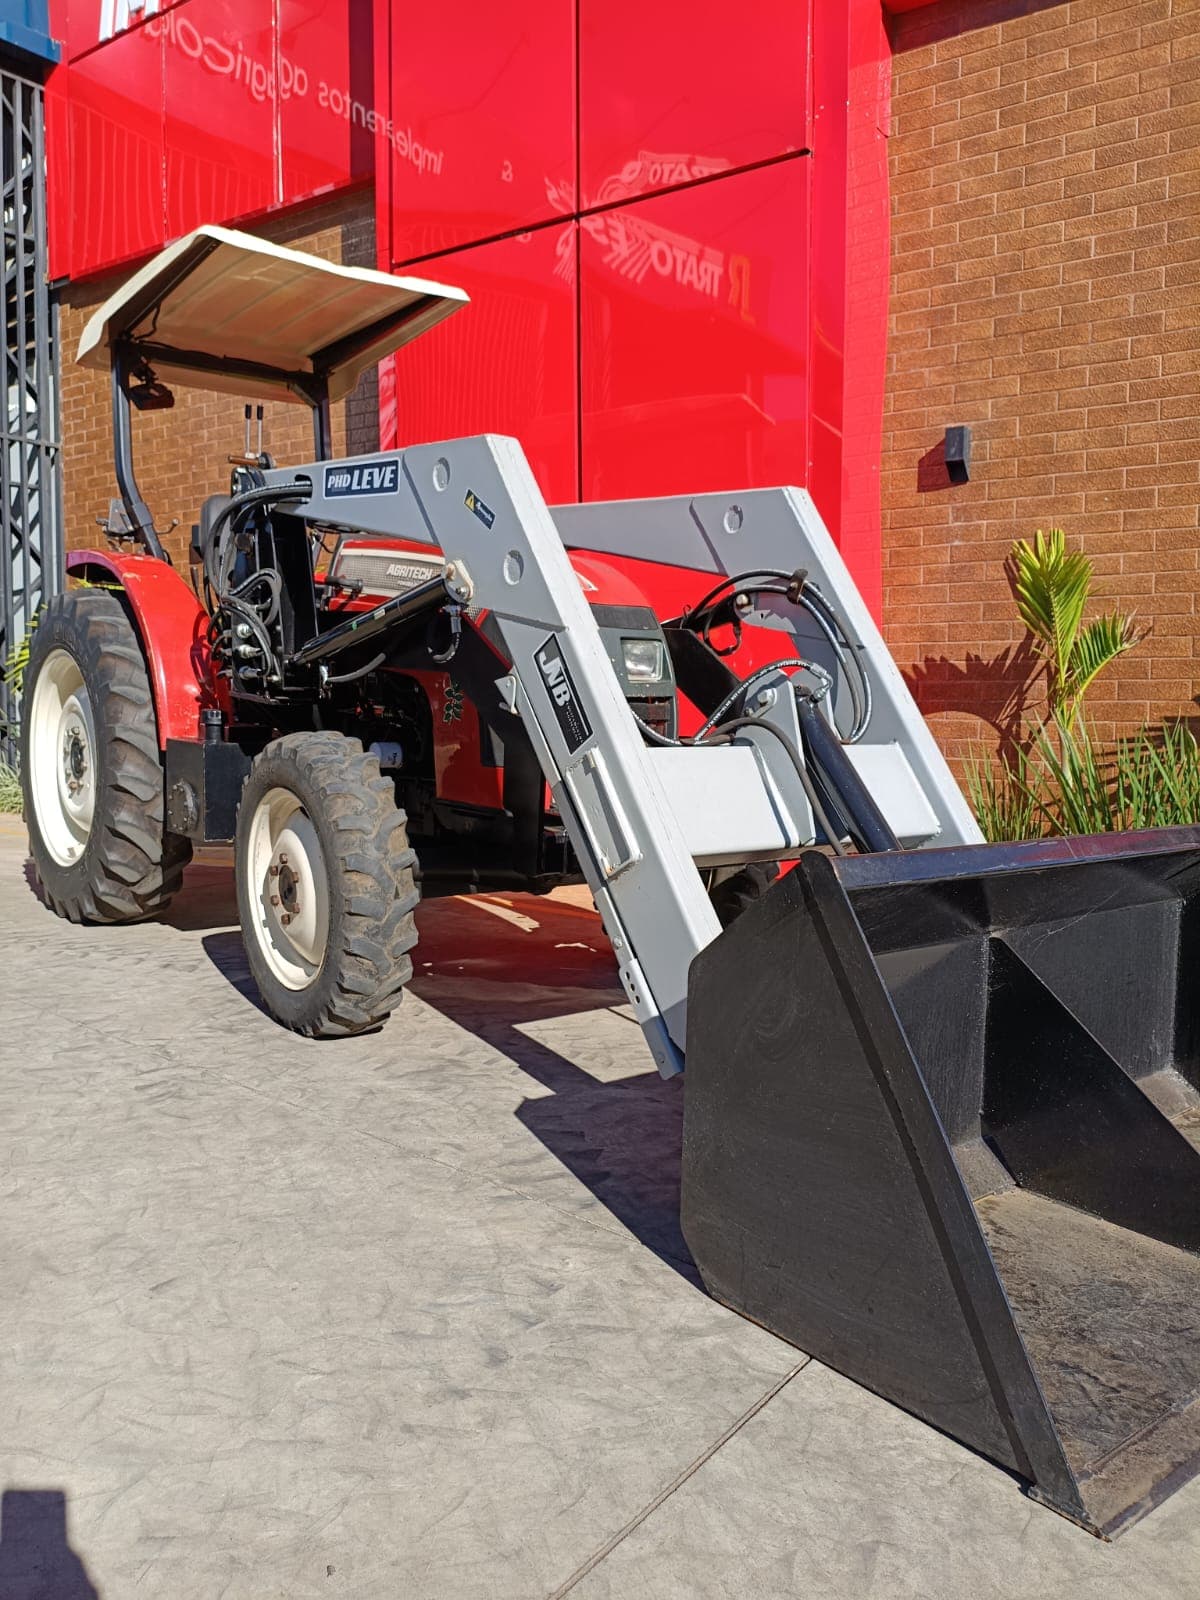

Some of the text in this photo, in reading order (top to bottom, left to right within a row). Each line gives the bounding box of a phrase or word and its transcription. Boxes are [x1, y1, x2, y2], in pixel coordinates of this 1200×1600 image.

[327, 465, 396, 490] PHD LEVE
[386, 564, 433, 580] AGRITECH
